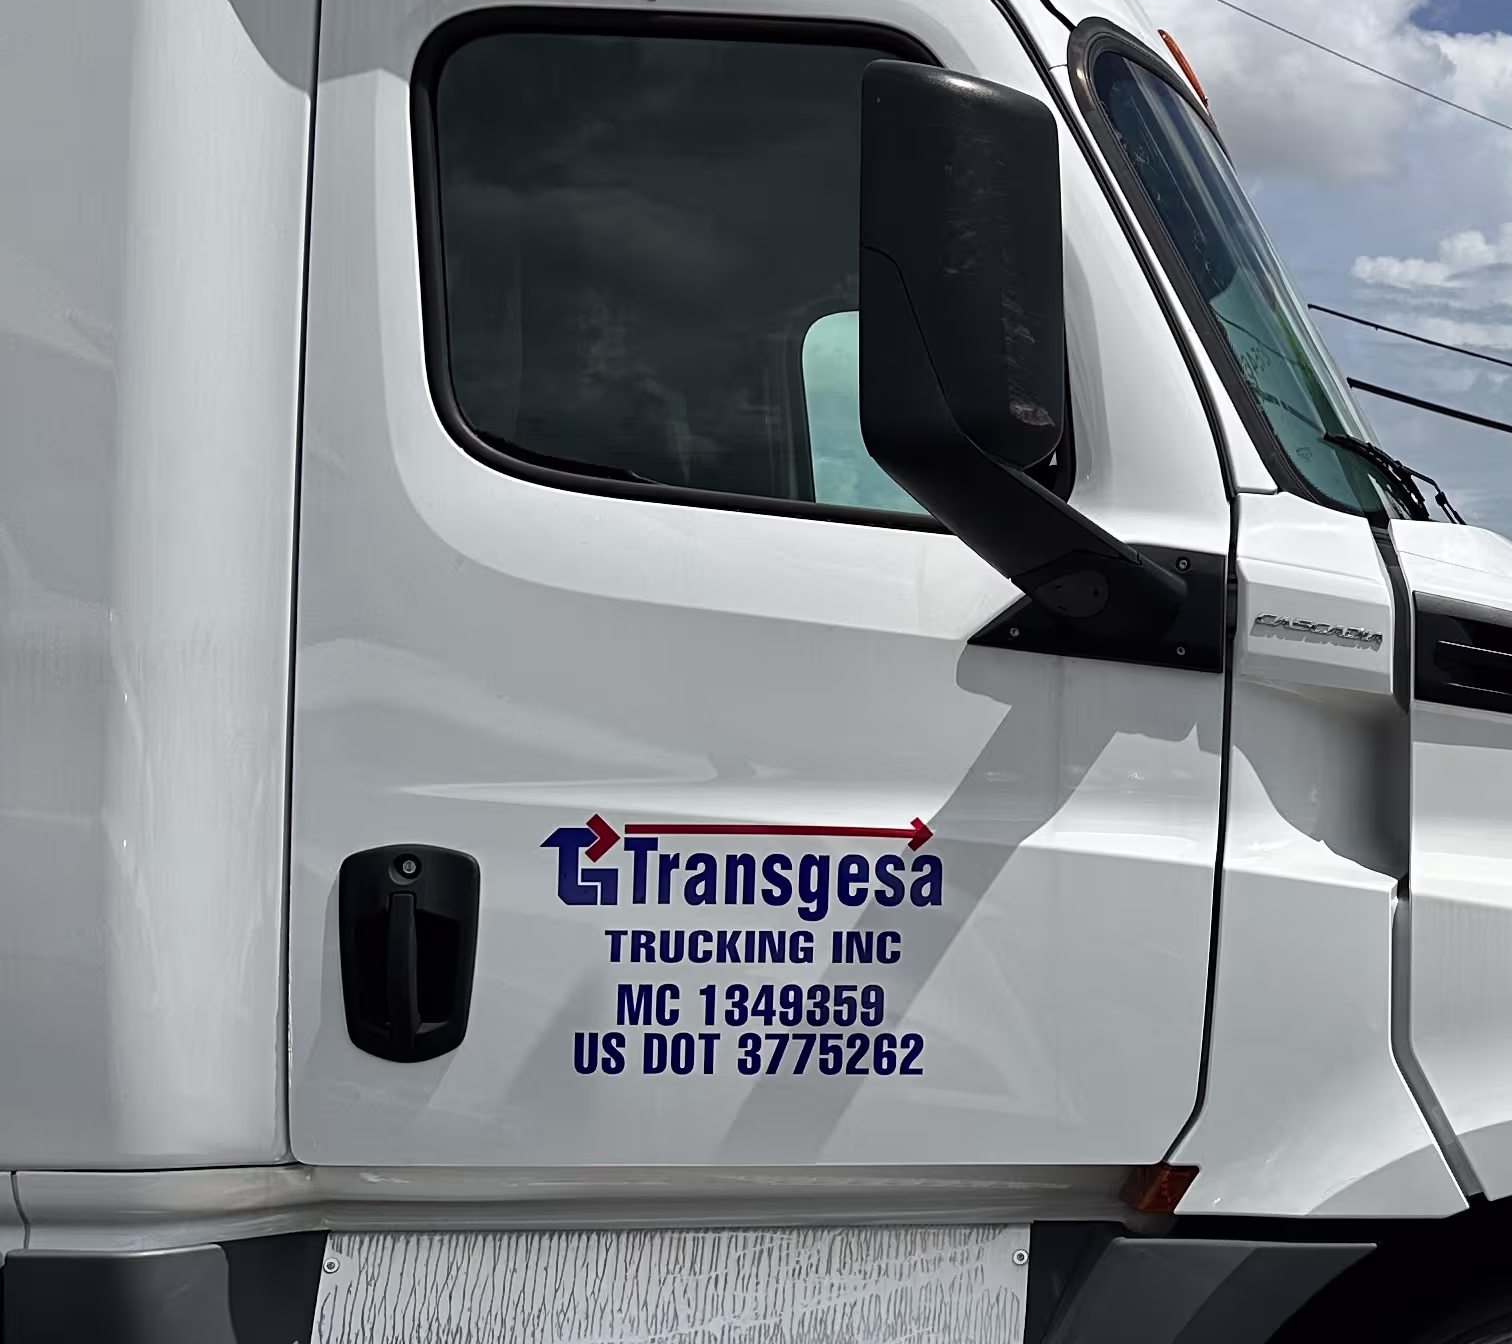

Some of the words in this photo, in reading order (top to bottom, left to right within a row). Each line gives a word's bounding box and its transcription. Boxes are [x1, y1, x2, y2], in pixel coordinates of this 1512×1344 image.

[623, 837, 943, 922] Transgesa
[604, 930, 814, 964] TRUCKING
[831, 931, 902, 964] INC
[616, 984, 681, 1026] MC
[699, 984, 885, 1027] 1349359
[574, 1032, 626, 1075] US
[642, 1033, 721, 1075] DOT
[737, 1033, 925, 1076] 3775262
